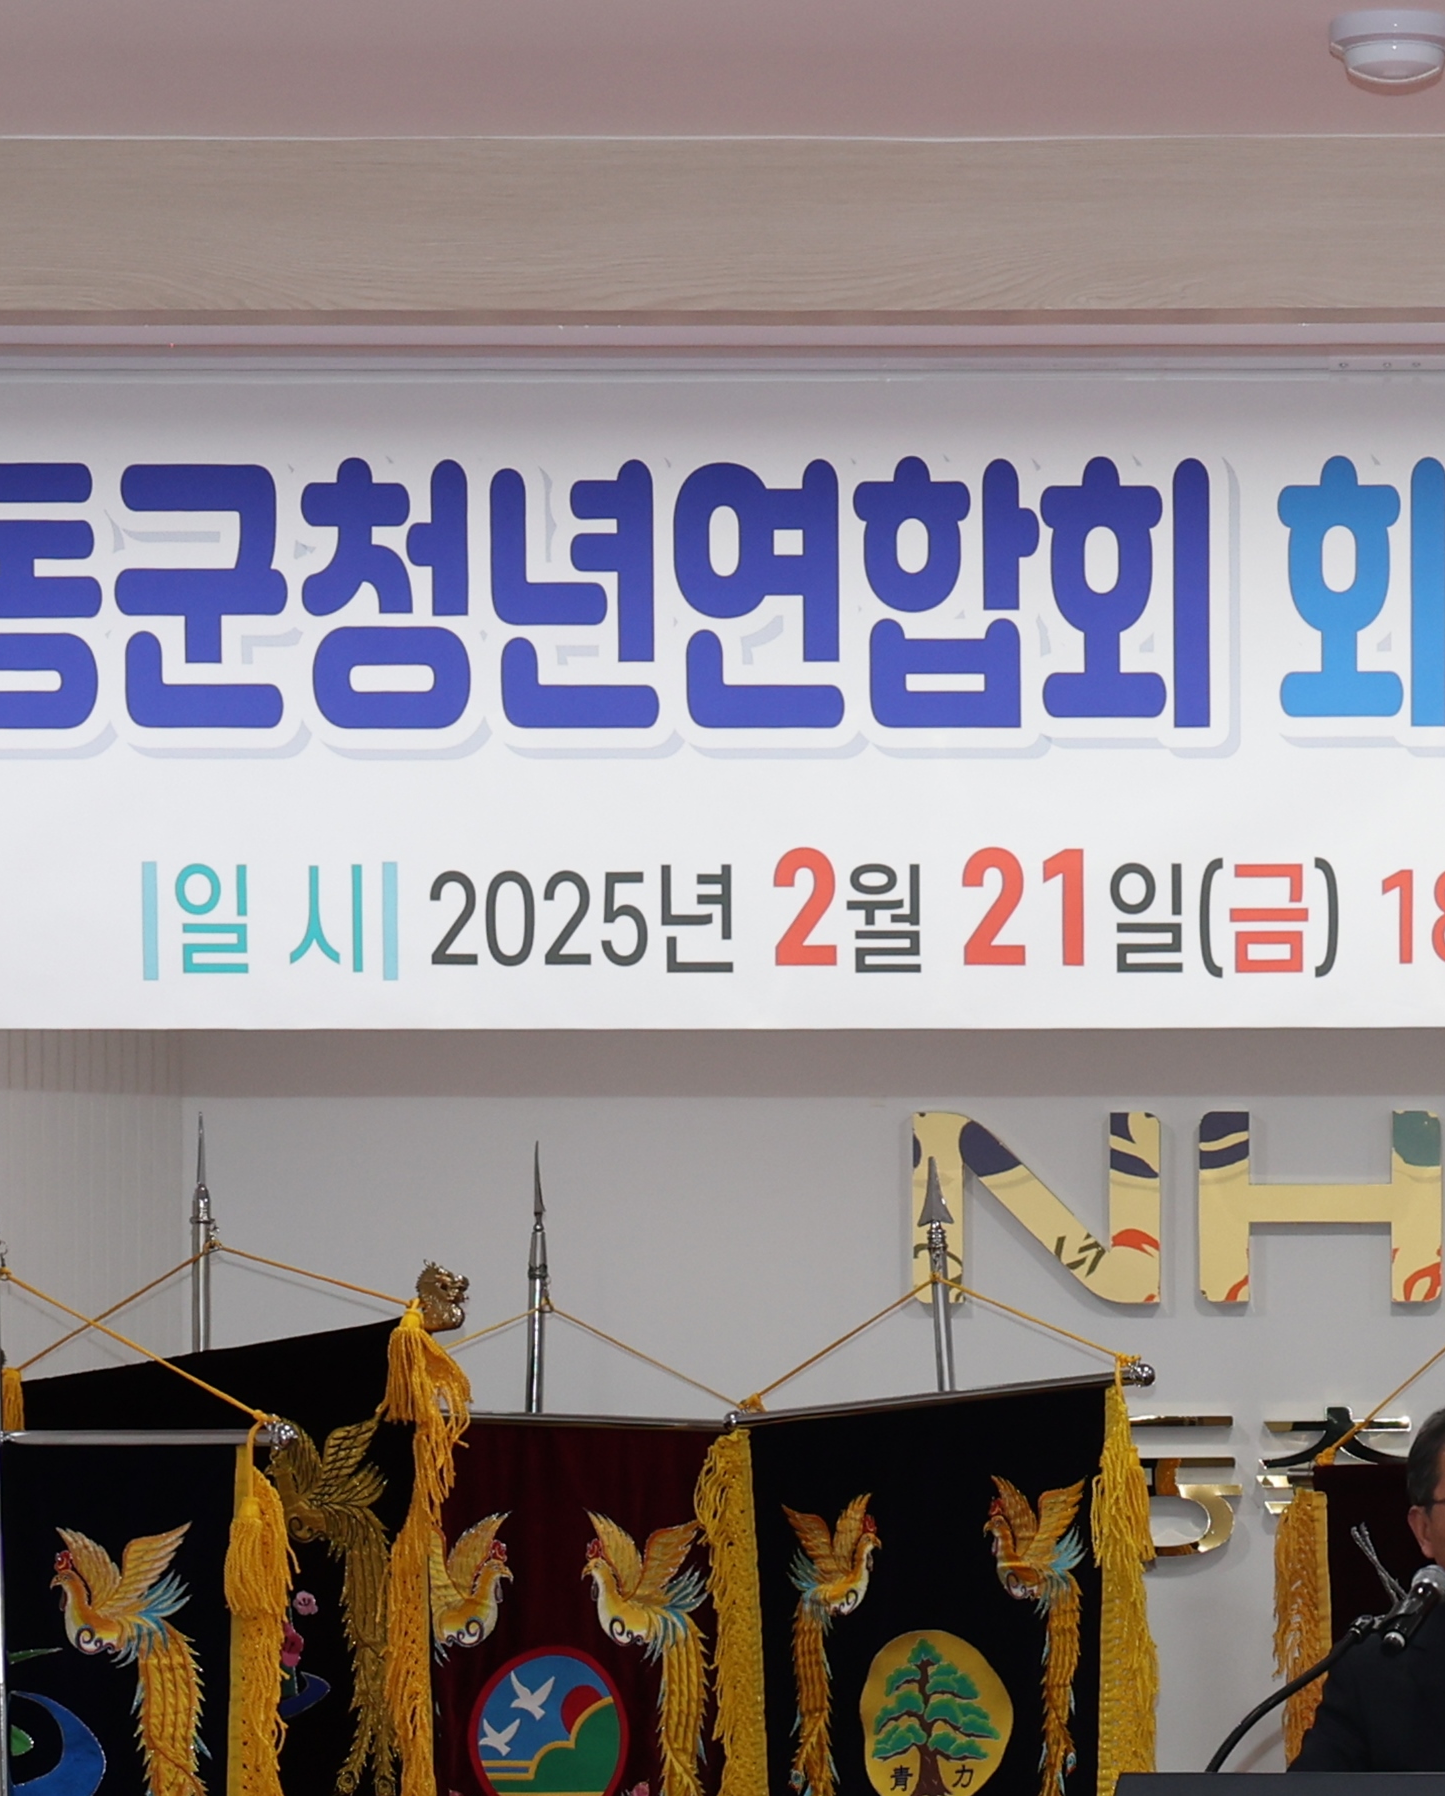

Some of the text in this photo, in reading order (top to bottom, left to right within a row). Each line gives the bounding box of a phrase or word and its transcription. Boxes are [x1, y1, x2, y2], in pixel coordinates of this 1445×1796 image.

[430, 864, 735, 975] 2025년
[772, 846, 924, 975] 2월
[961, 846, 1341, 980] 21일(금)
[911, 1110, 1444, 1304] NH
